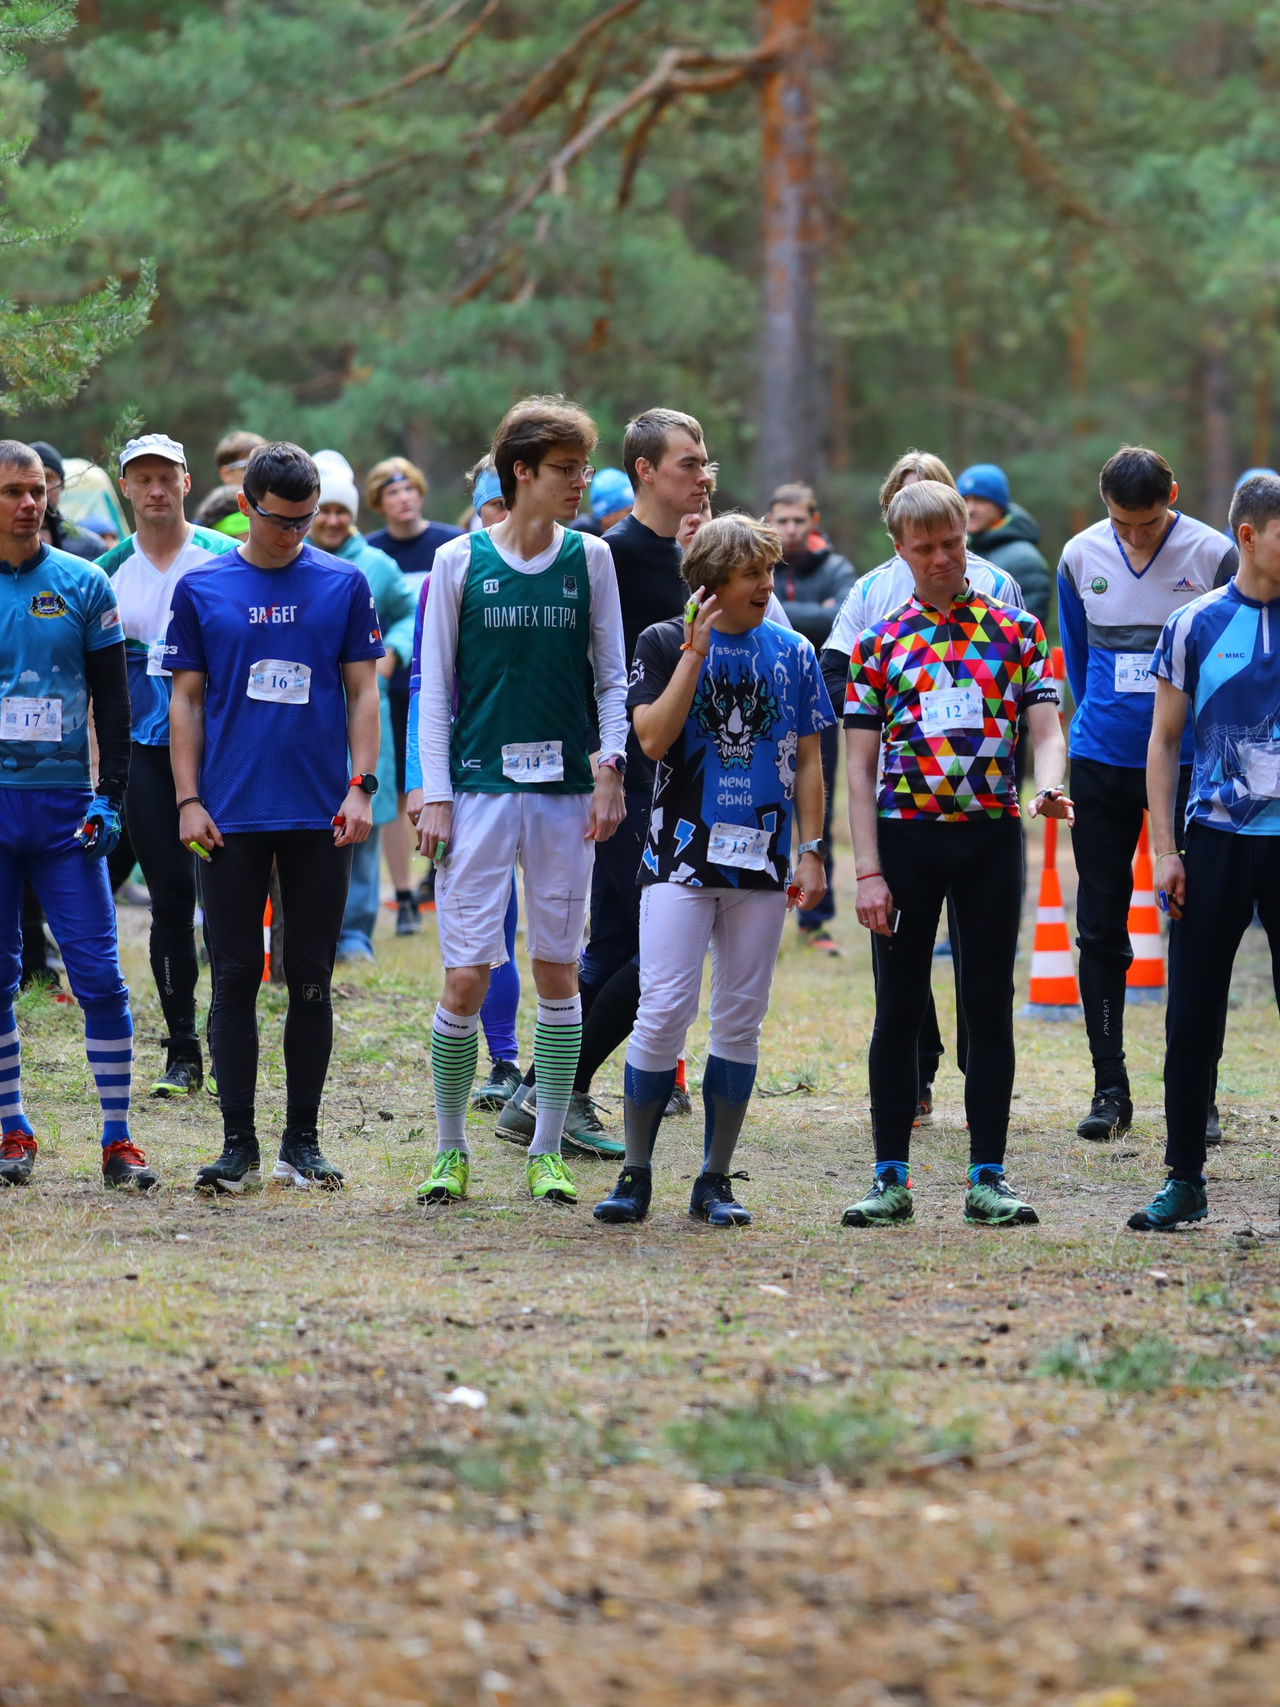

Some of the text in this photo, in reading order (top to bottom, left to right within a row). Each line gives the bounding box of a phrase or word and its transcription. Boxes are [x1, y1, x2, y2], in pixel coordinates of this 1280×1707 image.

[484, 605, 576, 629] ПОЛИТЕХ ПЕТРА
[1133, 668, 1150, 681] 29
[271, 674, 288, 690] 16
[945, 704, 962, 719] 12
[24, 713, 41, 727] 17
[525, 756, 541, 769] 14
[732, 841, 748, 854] 13
